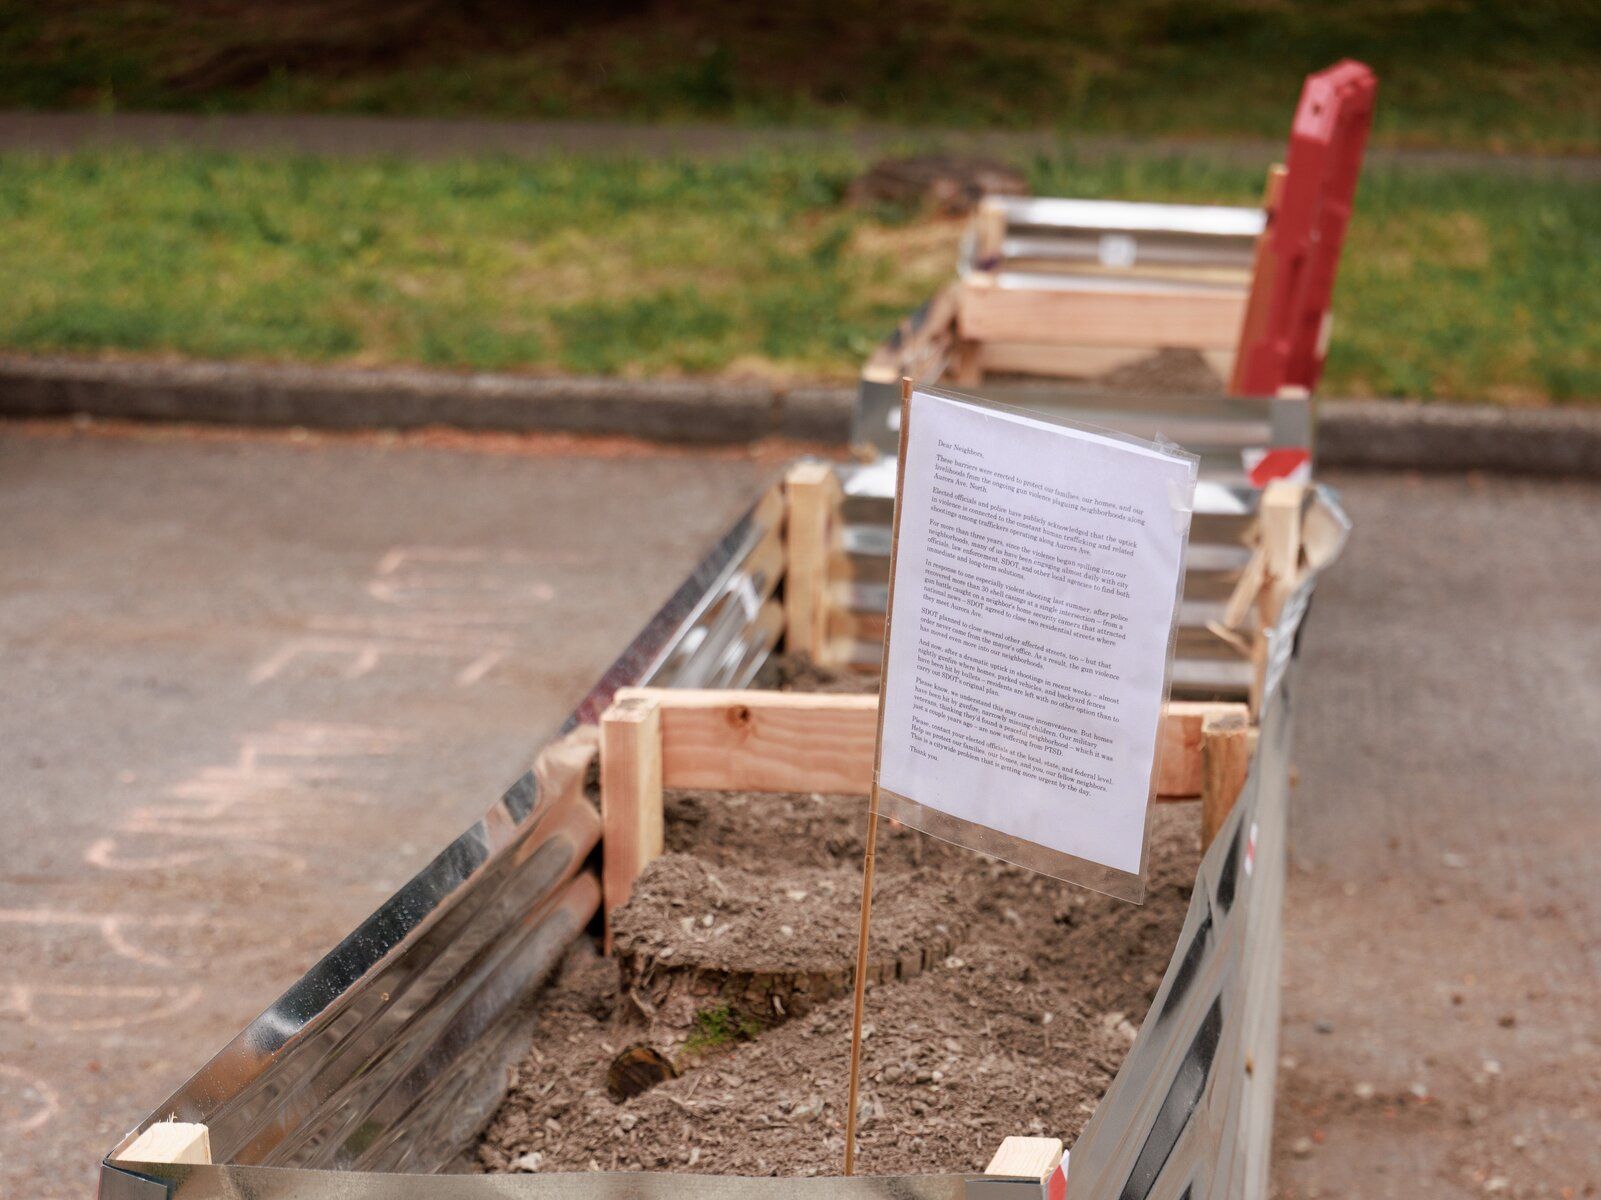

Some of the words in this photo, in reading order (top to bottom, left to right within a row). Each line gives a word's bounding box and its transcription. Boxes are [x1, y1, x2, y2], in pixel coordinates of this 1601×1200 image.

[938, 440, 953, 449] Dear
[934, 472, 955, 484] Aurora
[935, 463, 966, 478] livelihoods
[992, 482, 1016, 493] ongoing
[1028, 491, 1052, 502] violence
[1052, 498, 1079, 510] plaguing
[1080, 506, 1126, 521] neighborhoods
[1127, 516, 1145, 526] along
[936, 453, 954, 464] These
[954, 459, 978, 471] barriers
[993, 472, 1016, 482] erected
[1023, 481, 1044, 490] protect
[930, 505, 958, 518] shootings
[958, 514, 978, 525] among
[978, 519, 1009, 533] traffickers
[1009, 529, 1038, 542] operating
[1038, 536, 1055, 547] along
[1056, 540, 1078, 552] Aurora
[932, 486, 954, 498] Elected
[954, 494, 977, 505] officials
[990, 505, 1008, 514] police
[1023, 515, 1047, 526] publicly
[1047, 521, 1090, 536] acknowledged
[1118, 539, 1138, 548] uptick
[938, 498, 962, 510] violence
[968, 508, 998, 520] connected
[1016, 522, 1042, 533] constant
[1042, 527, 1063, 538] human
[1064, 534, 1097, 548] trafficking
[1112, 547, 1135, 556] related
[968, 558, 997, 571] long-term
[970, 531, 986, 541] three
[1032, 550, 1056, 561] violence
[1056, 555, 1076, 566] began
[1077, 563, 1101, 574] spilling
[1033, 560, 1061, 572] engaging
[1061, 567, 1083, 577] almost
[1083, 572, 1100, 583] daily
[1116, 581, 1128, 590] city
[975, 576, 1005, 590] especially
[1005, 584, 1025, 595] violent
[1026, 590, 1052, 603] shooting
[1093, 609, 1110, 617] after
[1110, 614, 1128, 622] police
[990, 589, 1005, 598] shell
[1005, 594, 1027, 605] casings
[1039, 604, 1058, 613] single
[1059, 608, 1096, 623] intersection
[1033, 569, 1051, 578] other
[1051, 572, 1066, 582] local
[1101, 586, 1115, 594] find
[1115, 589, 1131, 598] both
[921, 606, 938, 618] SDOT
[938, 614, 962, 626] planned
[968, 624, 983, 633] close
[983, 629, 1005, 639] several
[1004, 636, 1021, 644] other
[1021, 640, 1045, 652] affected
[936, 579, 952, 590] battle
[952, 587, 972, 597] caught
[1033, 612, 1057, 623] security
[1058, 619, 1081, 628] camera
[1096, 629, 1126, 639] attracted
[950, 602, 970, 614] Aurora
[967, 599, 984, 609] SDOT
[1012, 614, 1027, 622] close
[1040, 623, 1073, 635] residential
[1073, 632, 1095, 641] streets
[1096, 637, 1116, 646] where
[920, 617, 935, 626] order
[1094, 670, 1120, 680] violence
[916, 665, 931, 674] carry
[963, 681, 985, 692] original
[938, 655, 958, 665] gunfire
[997, 675, 1018, 685] parked
[1057, 691, 1086, 704] backyard
[1086, 699, 1106, 710] fences
[944, 648, 958, 657] after
[963, 653, 989, 667] dramatic
[989, 663, 1009, 673] uptick
[1016, 671, 1044, 684] shootings
[1052, 682, 1072, 691] recent
[1072, 688, 1093, 697] weeks
[1098, 694, 1119, 704] almost
[961, 670, 981, 681] bullets
[987, 680, 1013, 692] residents
[1058, 702, 1076, 711] other
[1076, 707, 1096, 716] option
[915, 677, 933, 688] Please
[959, 694, 992, 708] understand
[1018, 713, 1035, 721] cause
[1080, 730, 1092, 738] But
[1093, 733, 1113, 744] homes
[928, 709, 947, 719] couple
[947, 716, 963, 724] years
[1002, 734, 1029, 747] suffering
[939, 703, 963, 717] thinking
[981, 717, 999, 728] found
[1004, 726, 1028, 737] peaceful
[1028, 734, 1070, 749] neighborhood
[1075, 747, 1094, 756] which
[981, 710, 1008, 723] narrowly
[1008, 719, 1031, 730] missing
[1059, 732, 1072, 741] Our
[1072, 738, 1097, 749] military
[909, 744, 927, 757] Thank
[931, 724, 952, 734] contact
[965, 735, 986, 746] elected
[986, 742, 1009, 753] officials
[1074, 768, 1097, 780] federal
[932, 733, 952, 743] protect
[1057, 772, 1076, 783] fellow
[933, 741, 957, 753] citywide
[1000, 765, 1022, 776] getting
[1038, 777, 1058, 786] urgent
